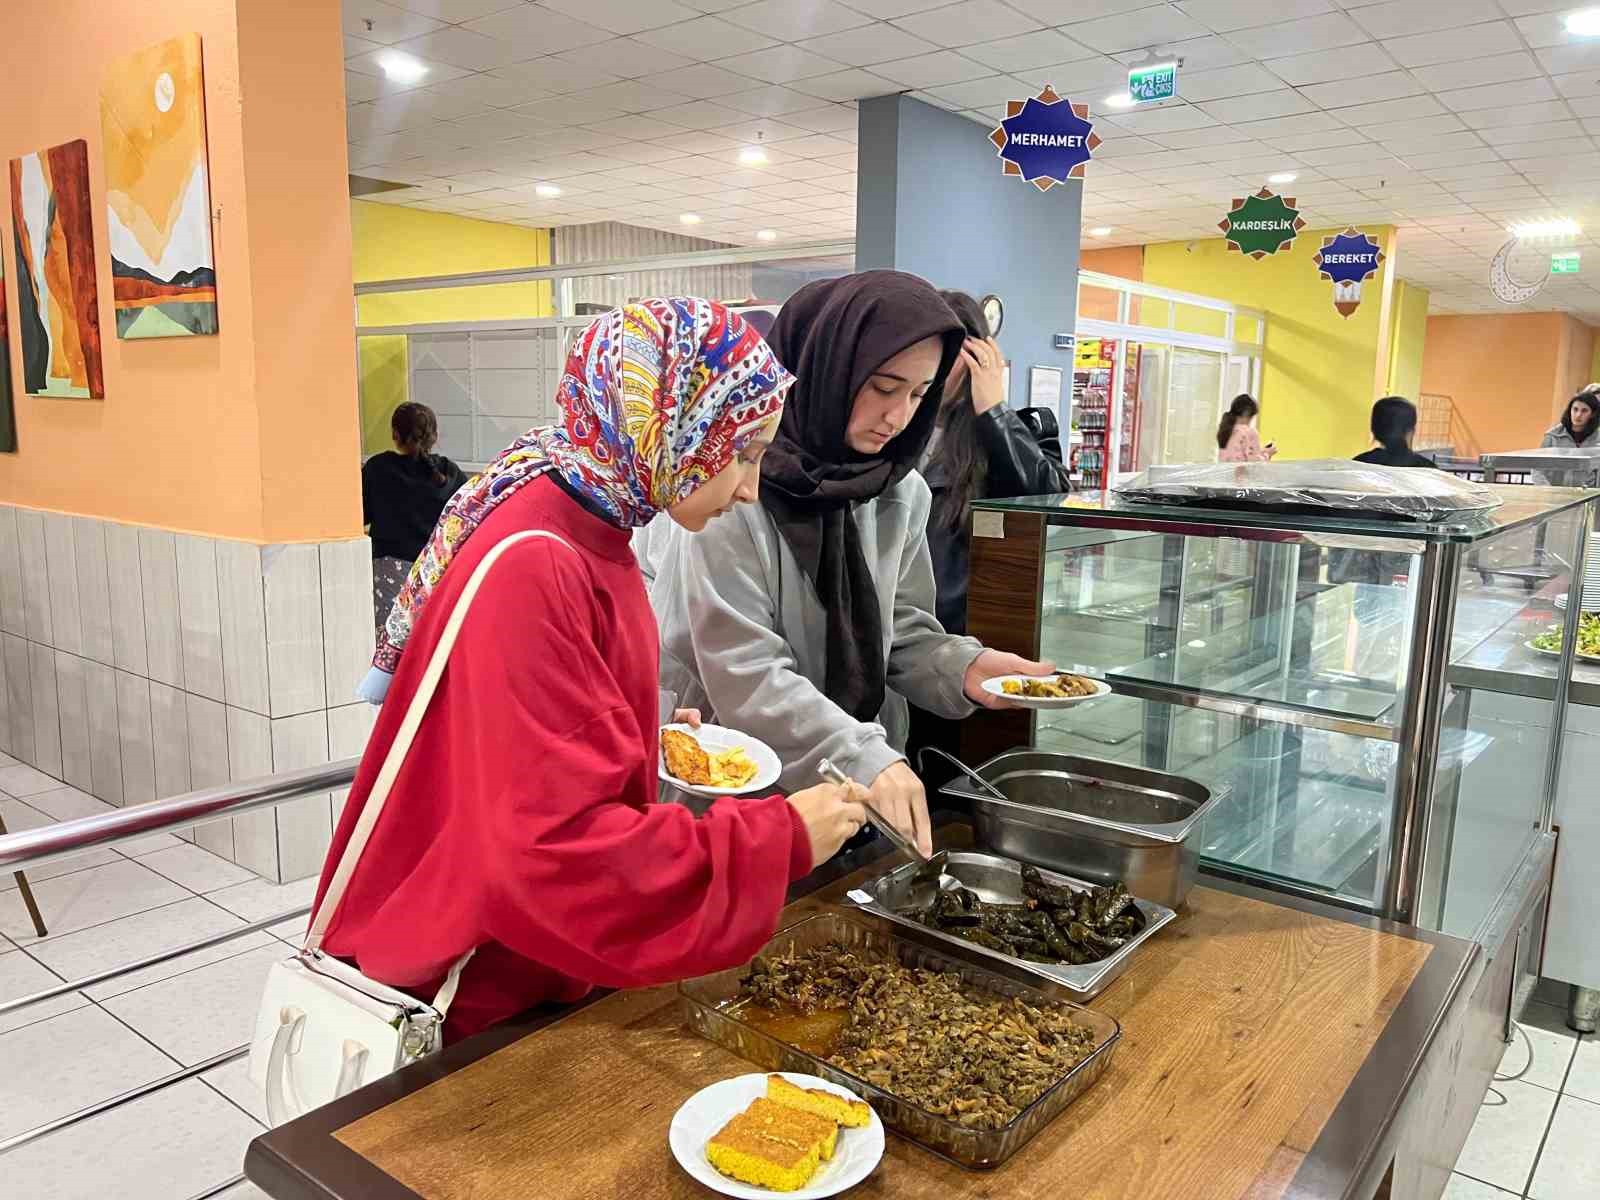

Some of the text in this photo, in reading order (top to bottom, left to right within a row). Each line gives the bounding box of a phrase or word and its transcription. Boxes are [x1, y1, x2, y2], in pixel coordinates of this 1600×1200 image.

[1156, 72, 1171, 83] EXIT
[1011, 133, 1083, 148] MERHAMET
[1232, 218, 1292, 231] KARDEŞLİK
[1324, 253, 1373, 264] BEREKET
